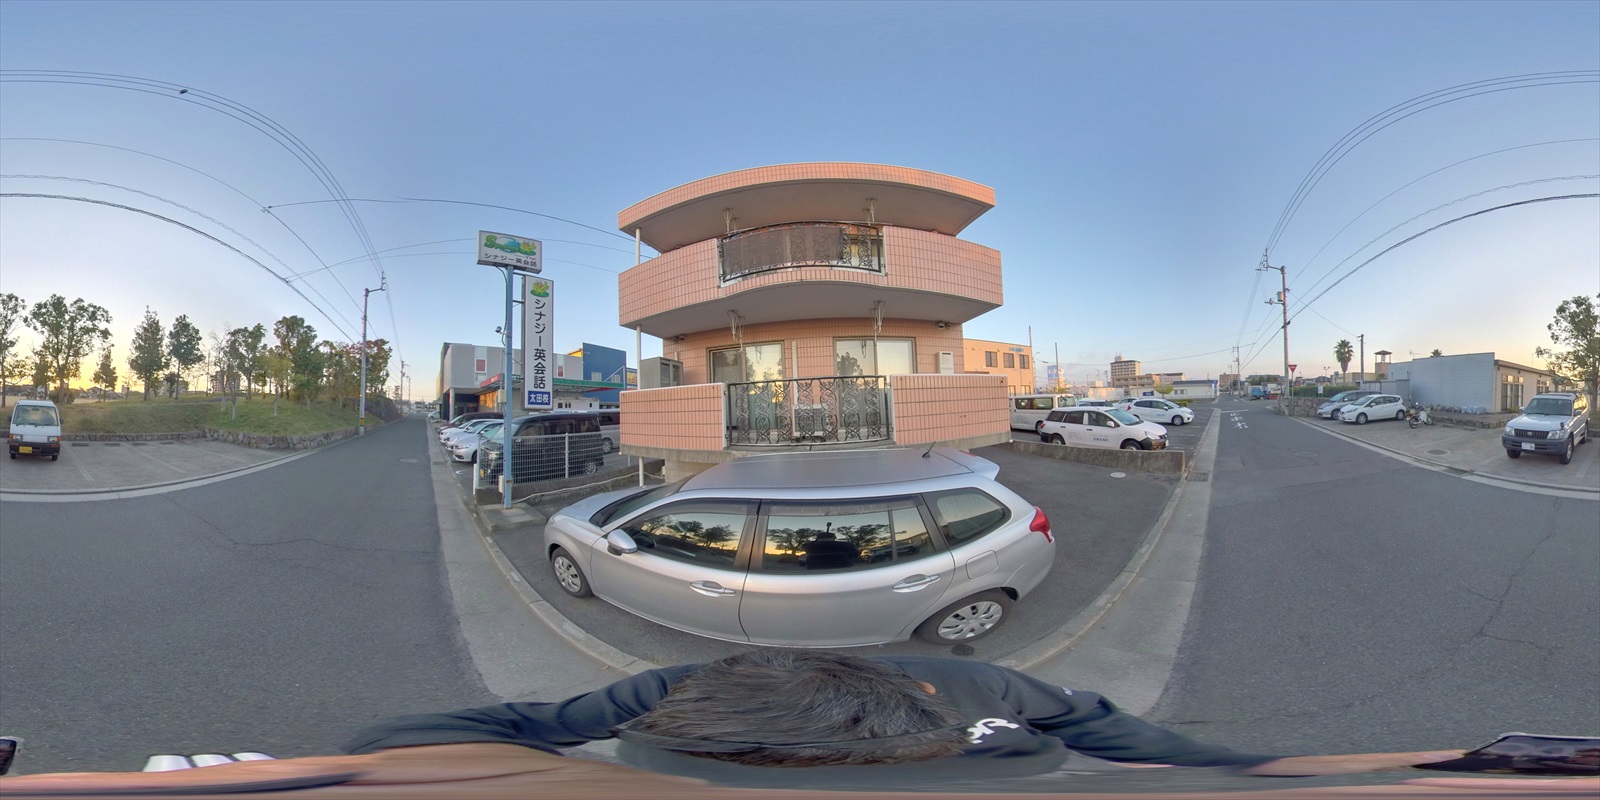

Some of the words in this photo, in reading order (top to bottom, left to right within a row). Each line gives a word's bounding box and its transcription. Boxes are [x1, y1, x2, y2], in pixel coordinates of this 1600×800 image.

[484, 252, 537, 268] シナジー英会話
[534, 298, 546, 389] シナジー英会話
[529, 393, 550, 404] 太田校
